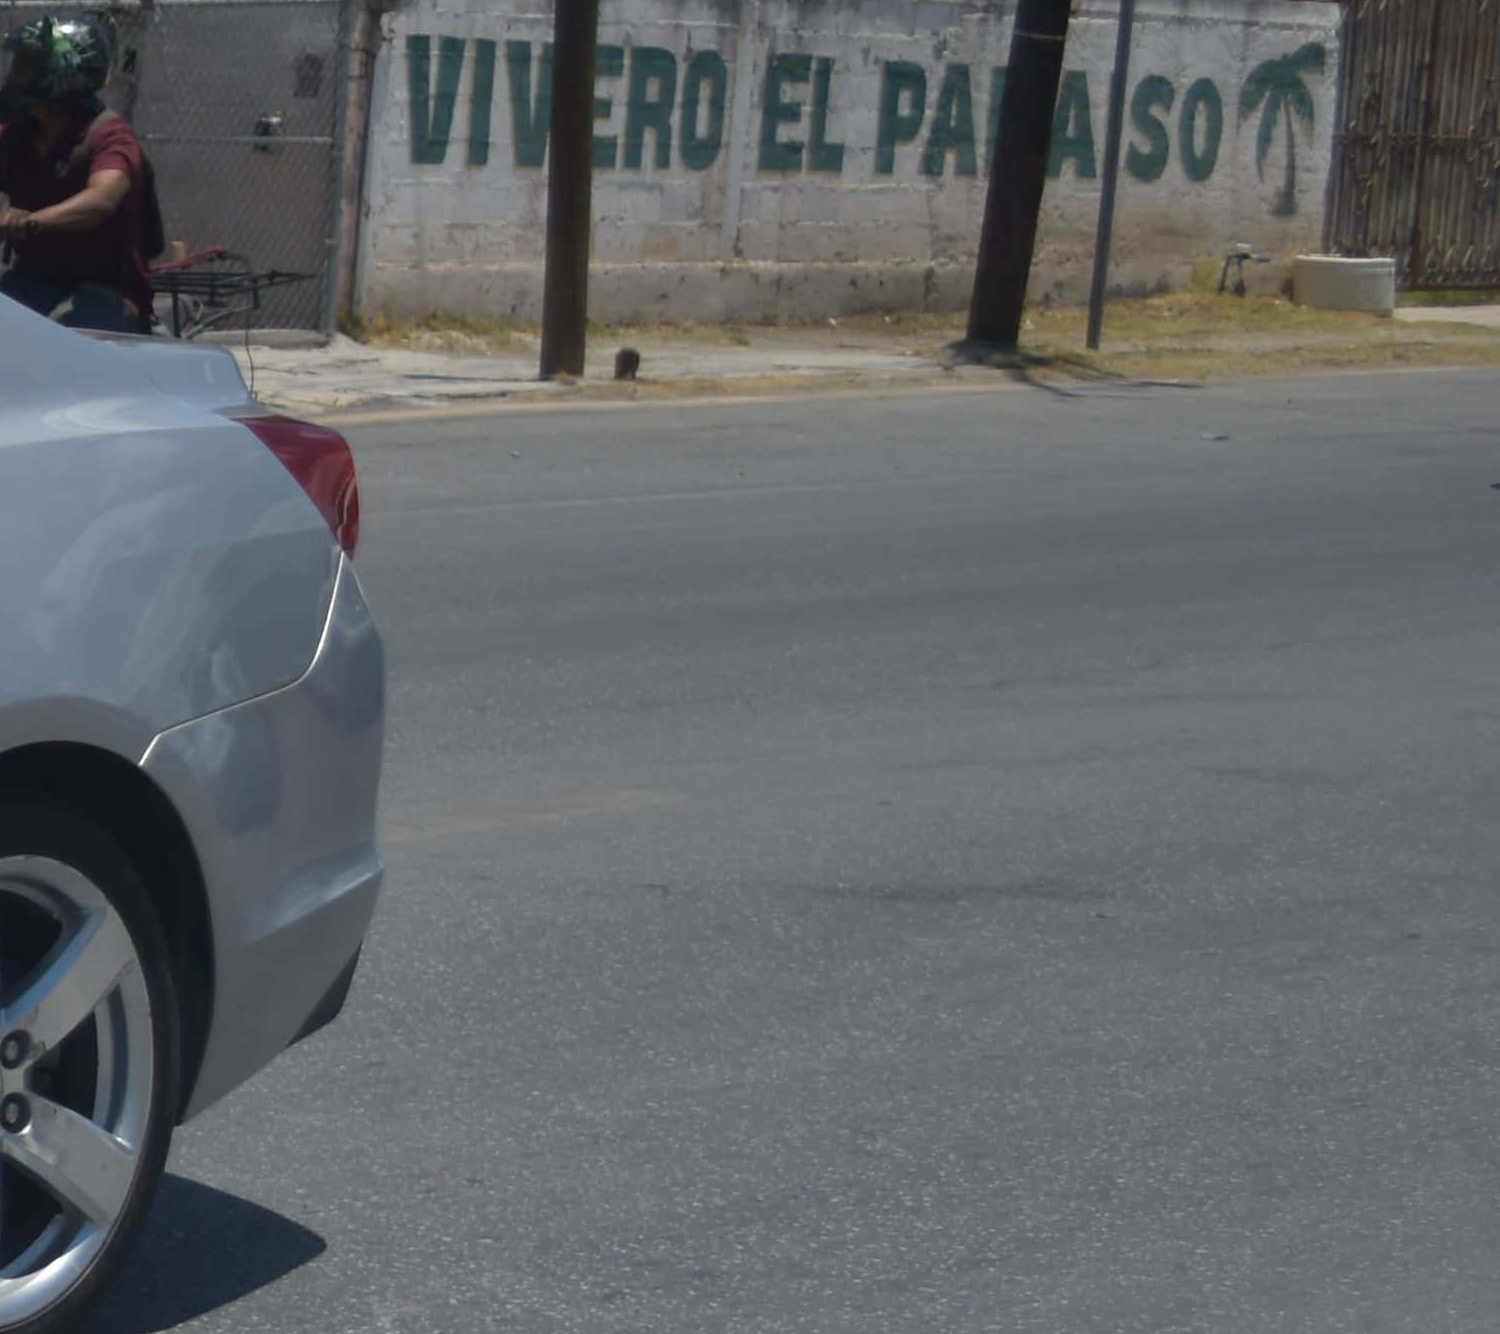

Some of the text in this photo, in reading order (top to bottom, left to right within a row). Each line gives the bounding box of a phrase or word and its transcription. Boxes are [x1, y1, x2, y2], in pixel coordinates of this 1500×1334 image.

[405, 33, 1224, 183] VIVERO EL PAASO
